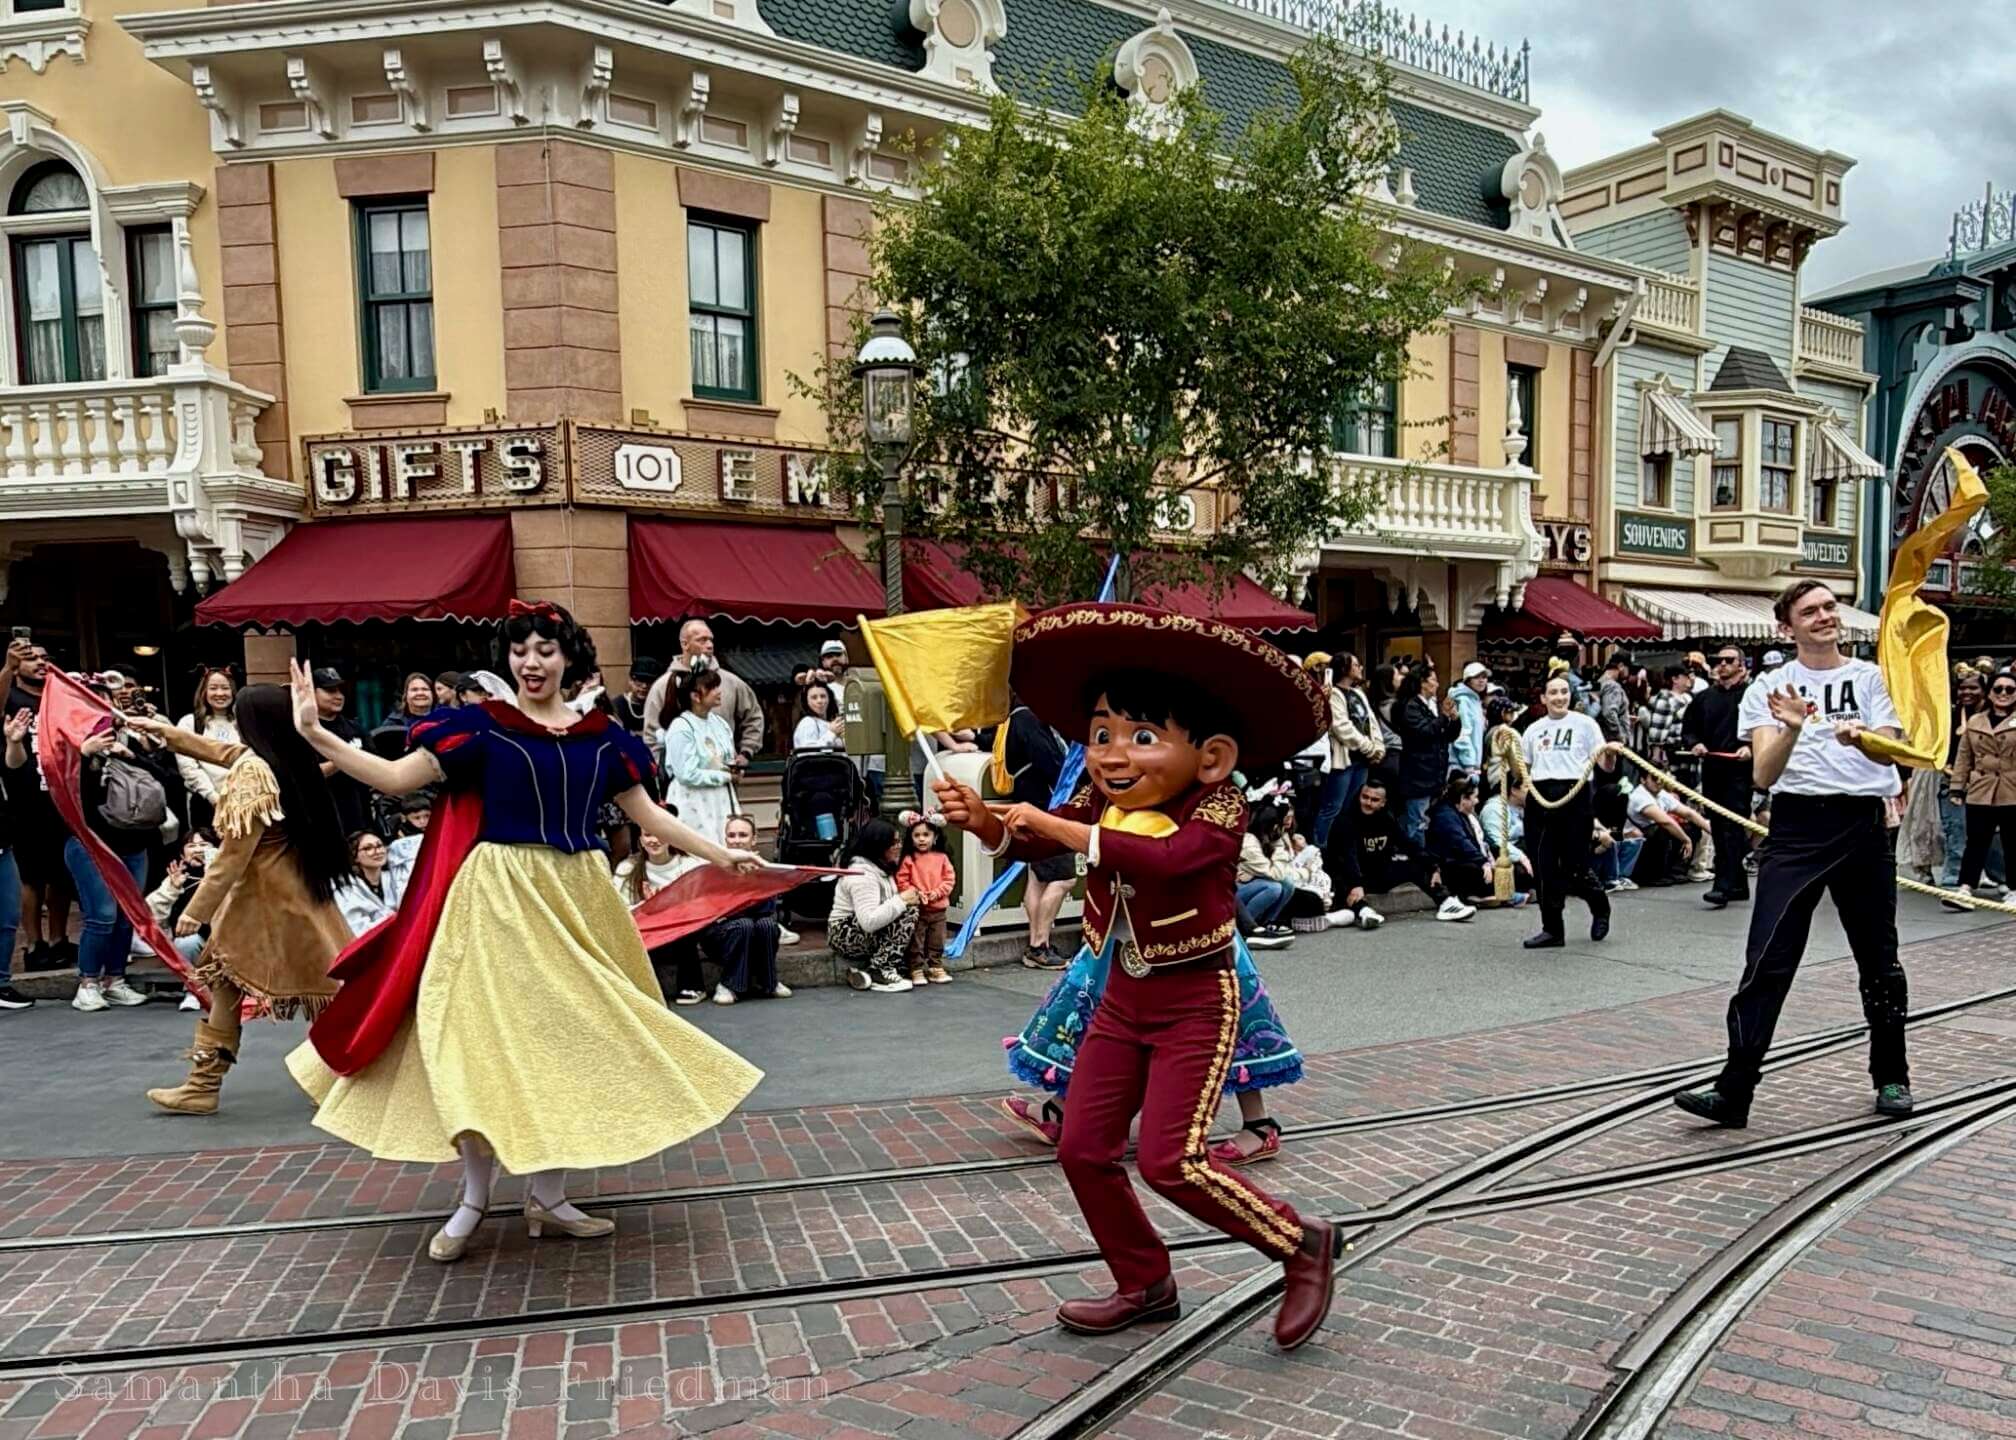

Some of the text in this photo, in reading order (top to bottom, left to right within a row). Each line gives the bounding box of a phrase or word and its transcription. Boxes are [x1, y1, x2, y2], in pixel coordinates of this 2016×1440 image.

[315, 436, 546, 501] GIFTS
[623, 452, 674, 481] 101
[1623, 523, 1686, 551] SOUVENIRS
[1825, 680, 1859, 714] LA
[1554, 728, 1573, 746] LA
